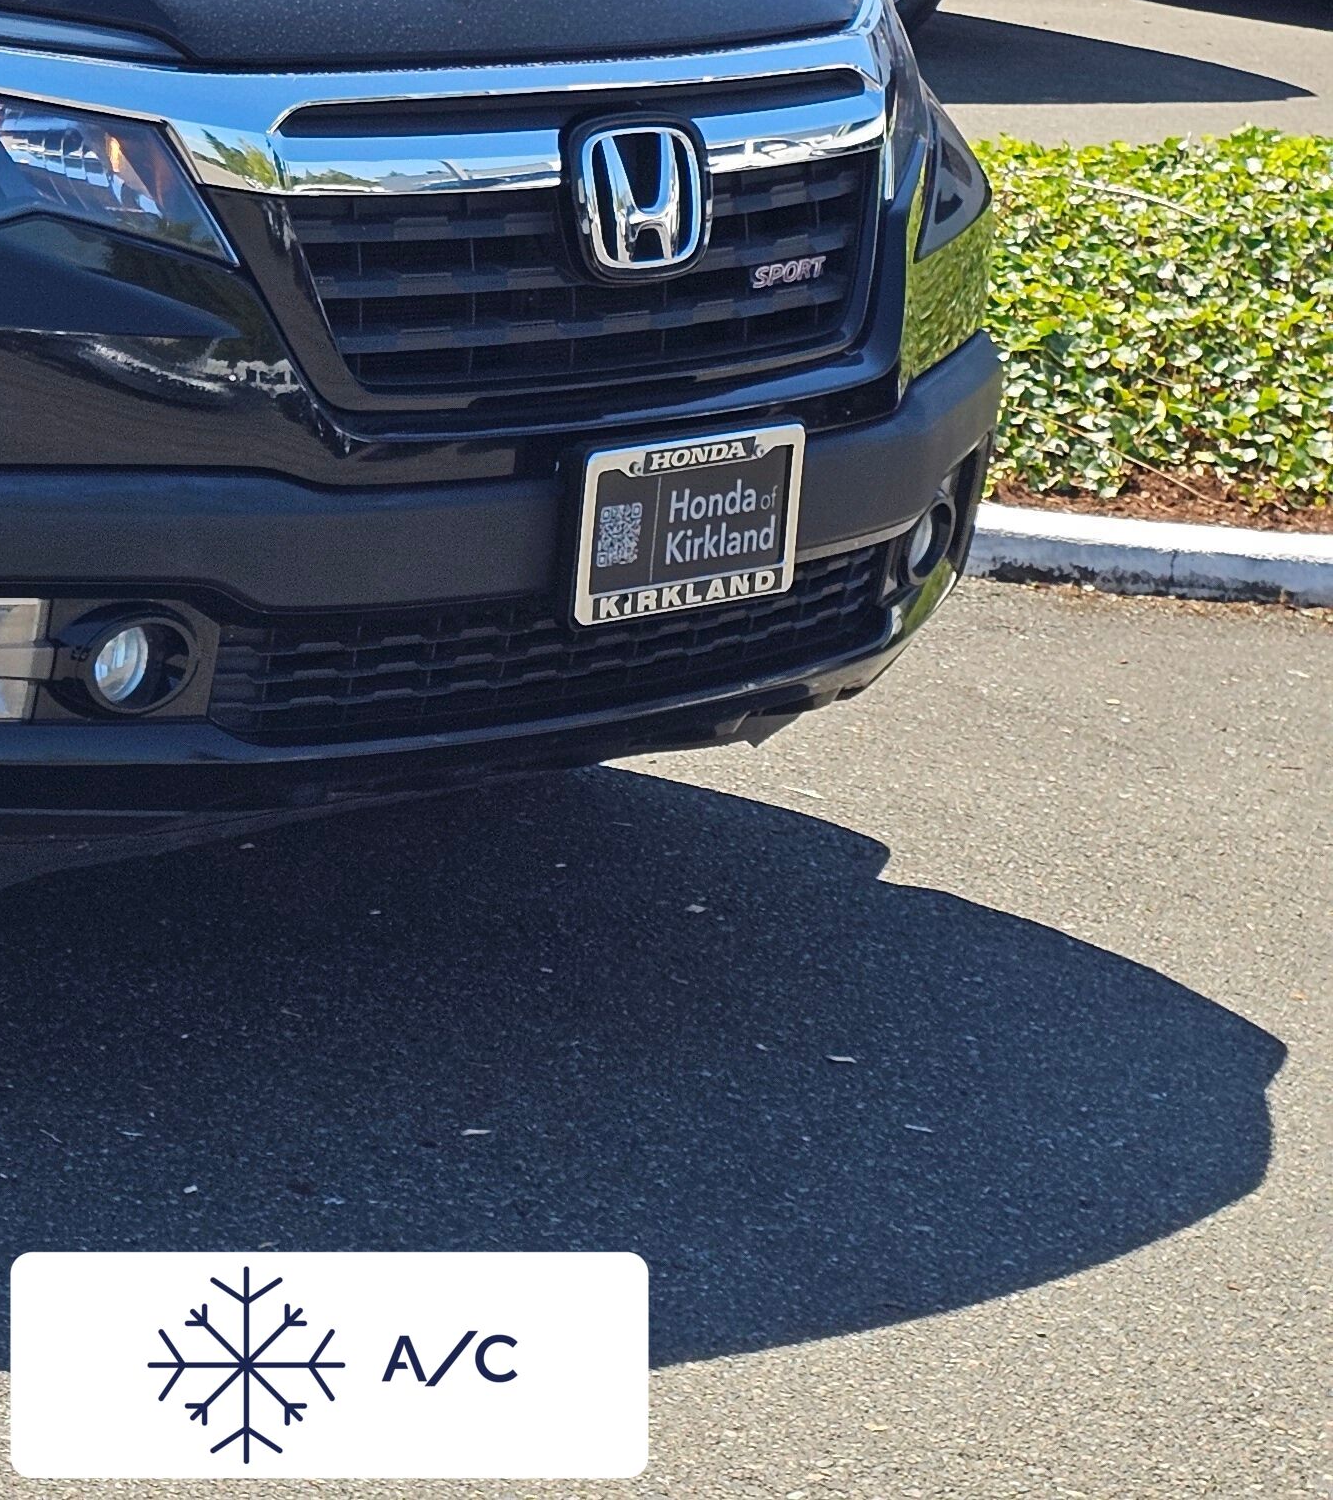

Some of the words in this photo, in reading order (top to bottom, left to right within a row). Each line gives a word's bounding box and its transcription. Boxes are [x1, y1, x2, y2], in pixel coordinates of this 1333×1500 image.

[751, 256, 827, 289] SPORT
[649, 440, 747, 471] HONDA
[668, 479, 756, 524] Honda
[760, 485, 779, 510] of
[665, 514, 777, 566] Kirkland
[598, 570, 777, 619] KIRKLAND
